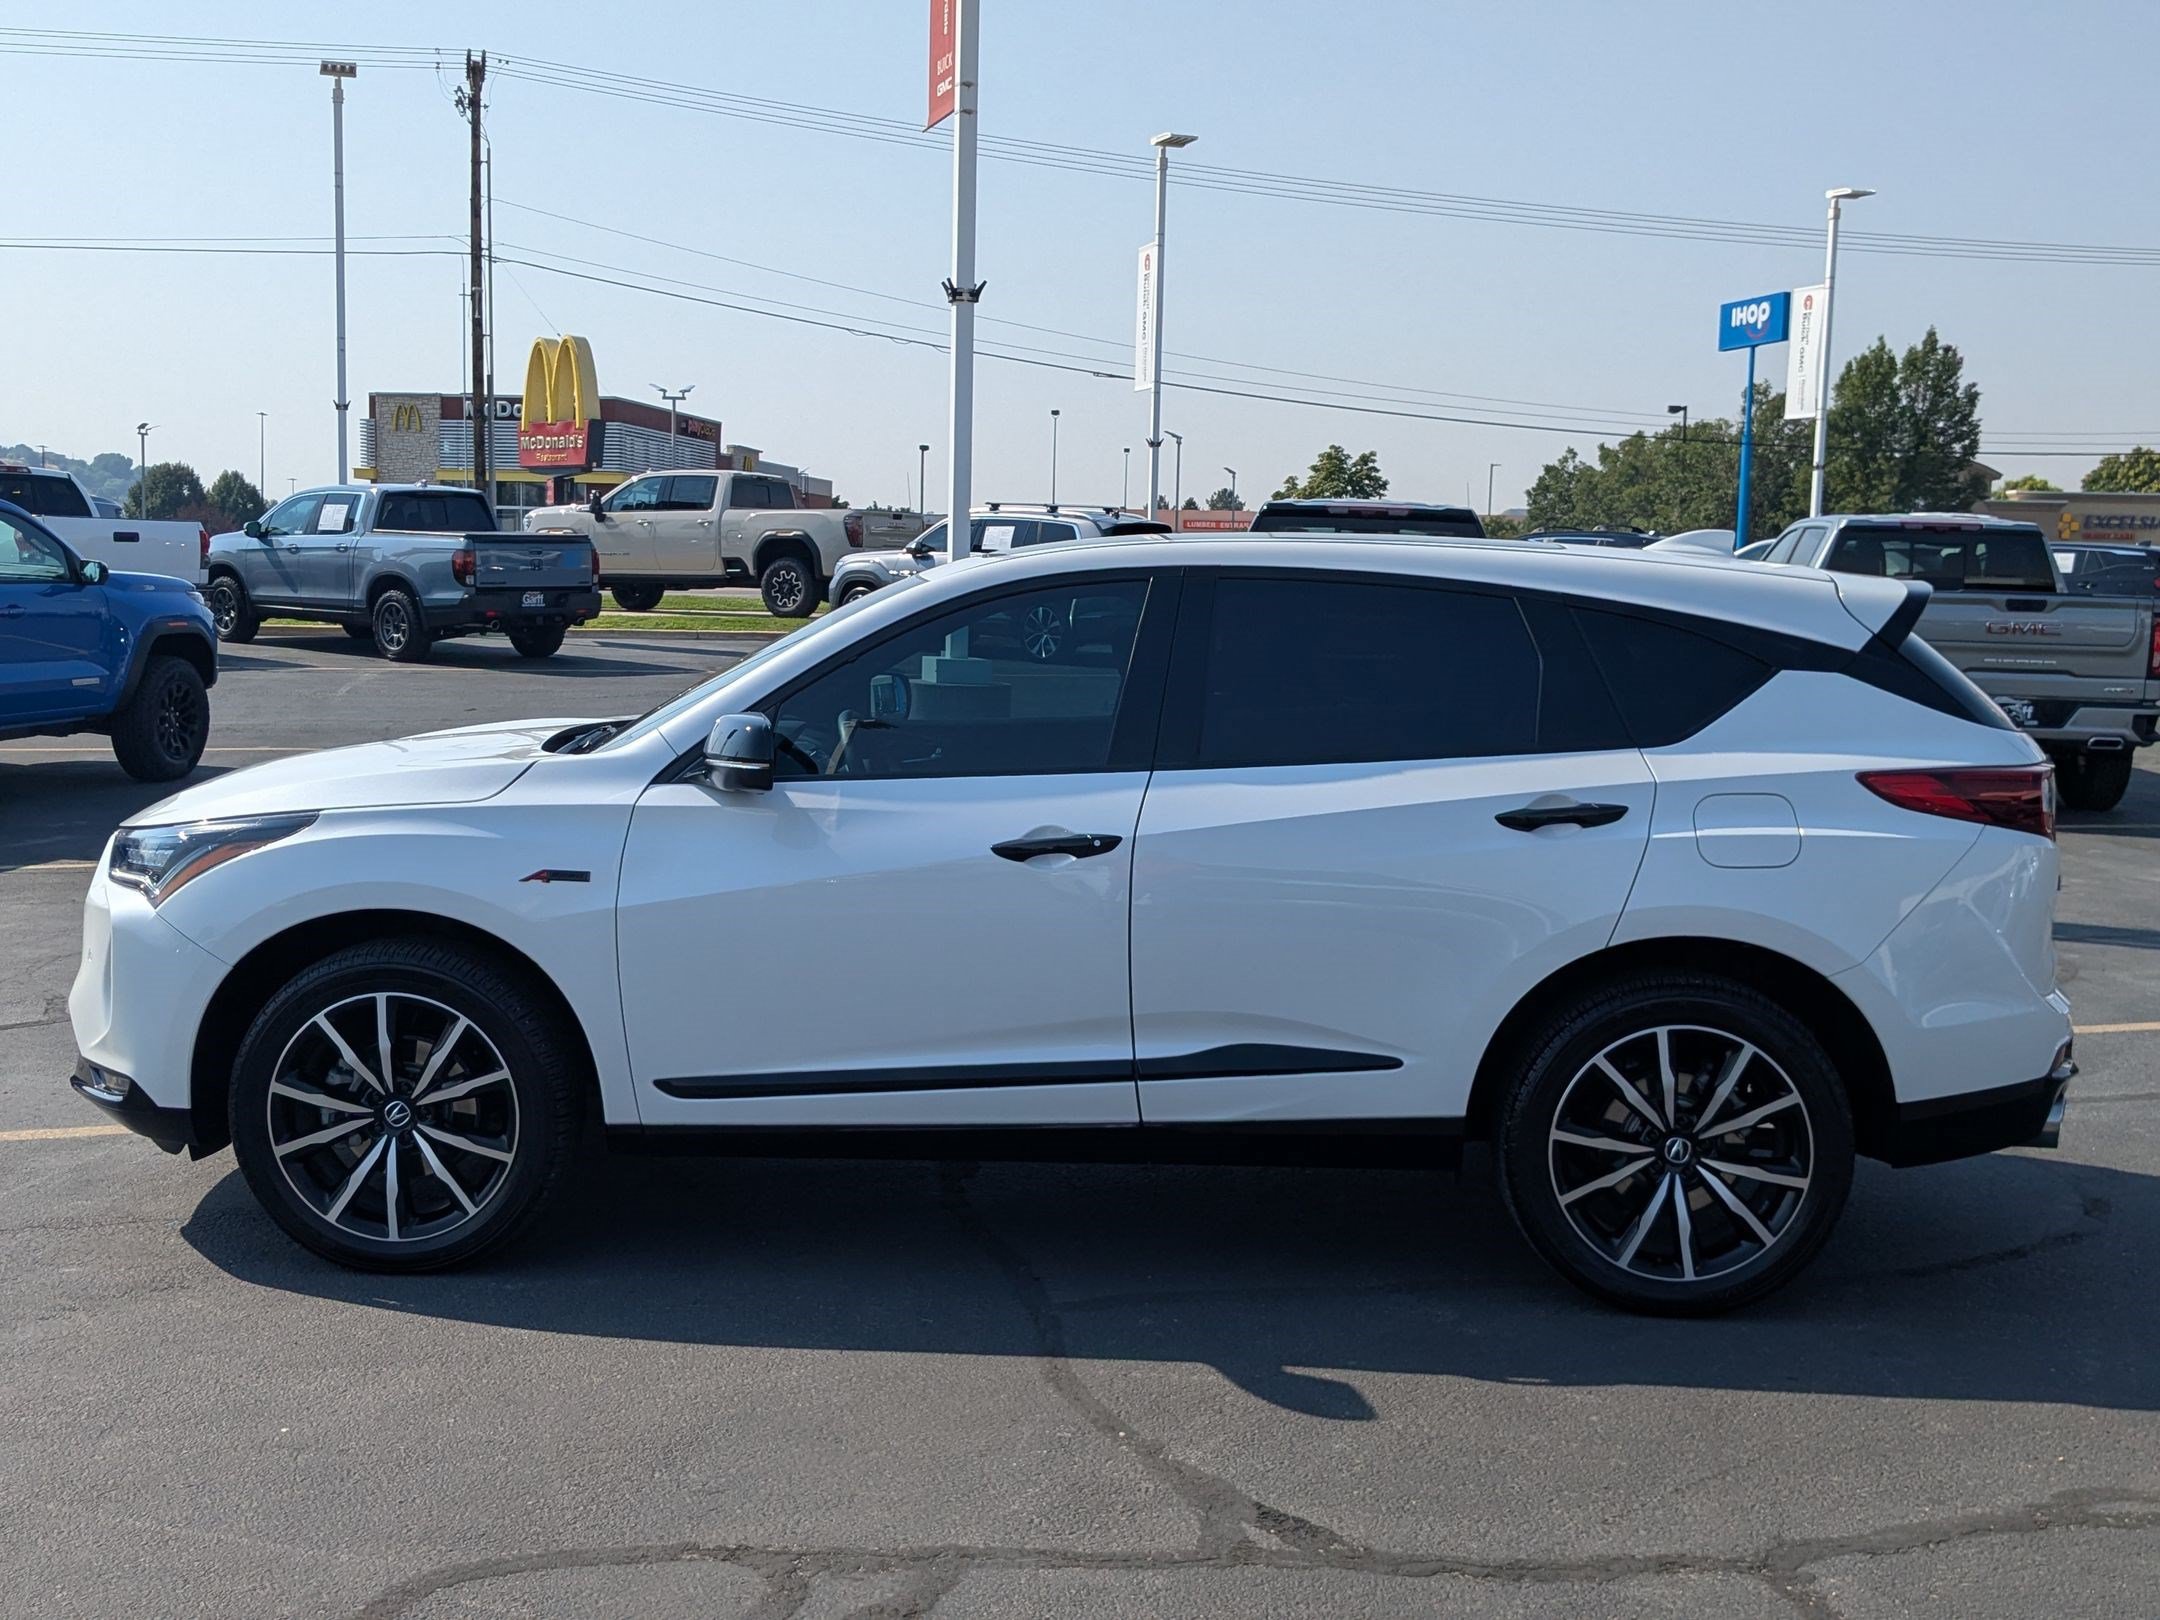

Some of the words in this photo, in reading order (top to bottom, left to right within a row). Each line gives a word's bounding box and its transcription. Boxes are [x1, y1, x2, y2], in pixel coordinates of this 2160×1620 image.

[936, 51, 953, 76] BUICK
[936, 76, 953, 97] GMC
[1731, 301, 1770, 330] IHOP
[520, 434, 585, 450] McDonald's
[522, 593, 544, 605] Garff
[1985, 621, 2064, 636] GMC
